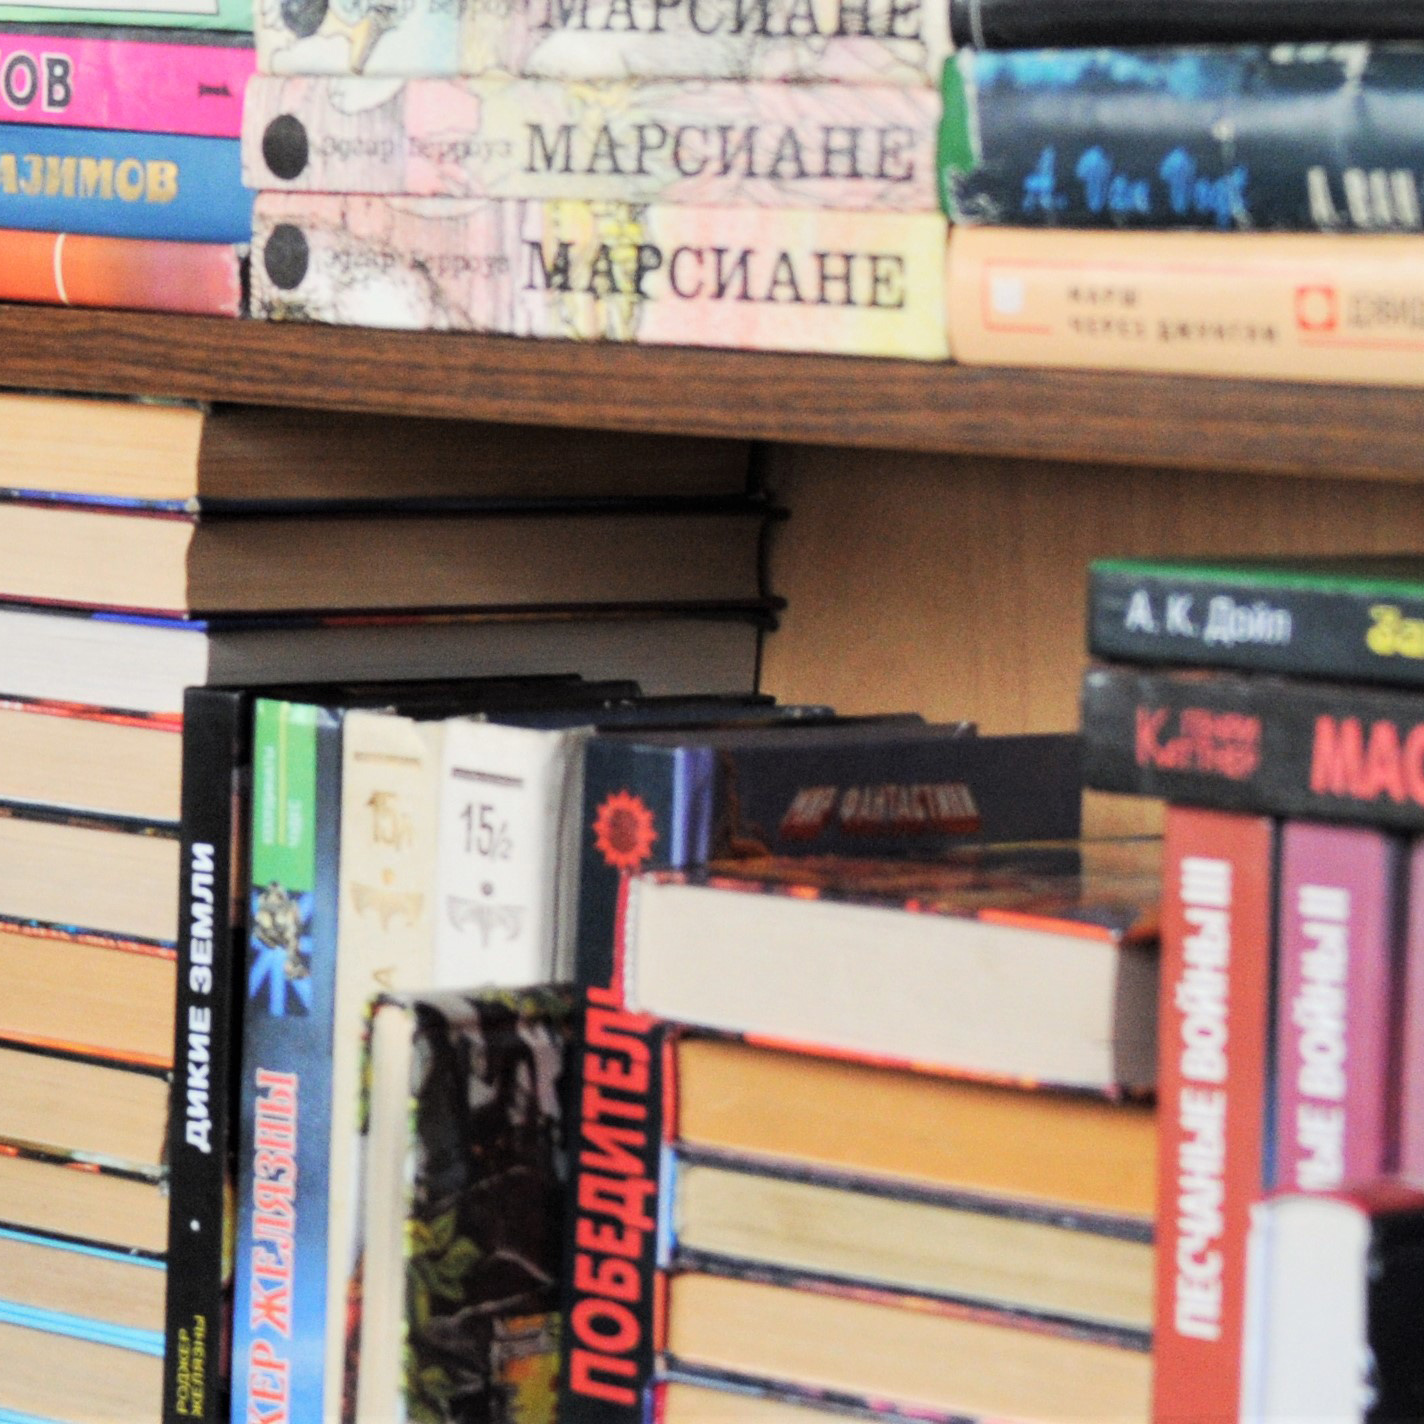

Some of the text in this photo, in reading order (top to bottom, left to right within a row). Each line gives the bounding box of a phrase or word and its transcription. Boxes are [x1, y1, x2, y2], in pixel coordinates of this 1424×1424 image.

[524, 123, 916, 181] МАРСИАНЕ
[523, 237, 907, 309] МАРСИАНЕ
[185, 841, 216, 1153] ДИКИЕ ЗЕМЛИ
[1174, 904, 1230, 1084] ВОЙНЫ
[1292, 919, 1348, 1101] ВОЙНЫ
[250, 1066, 299, 1335] ЖЕЛЯЗНЫ
[1173, 1084, 1226, 1342] ПЕСЧАНЫЕ
